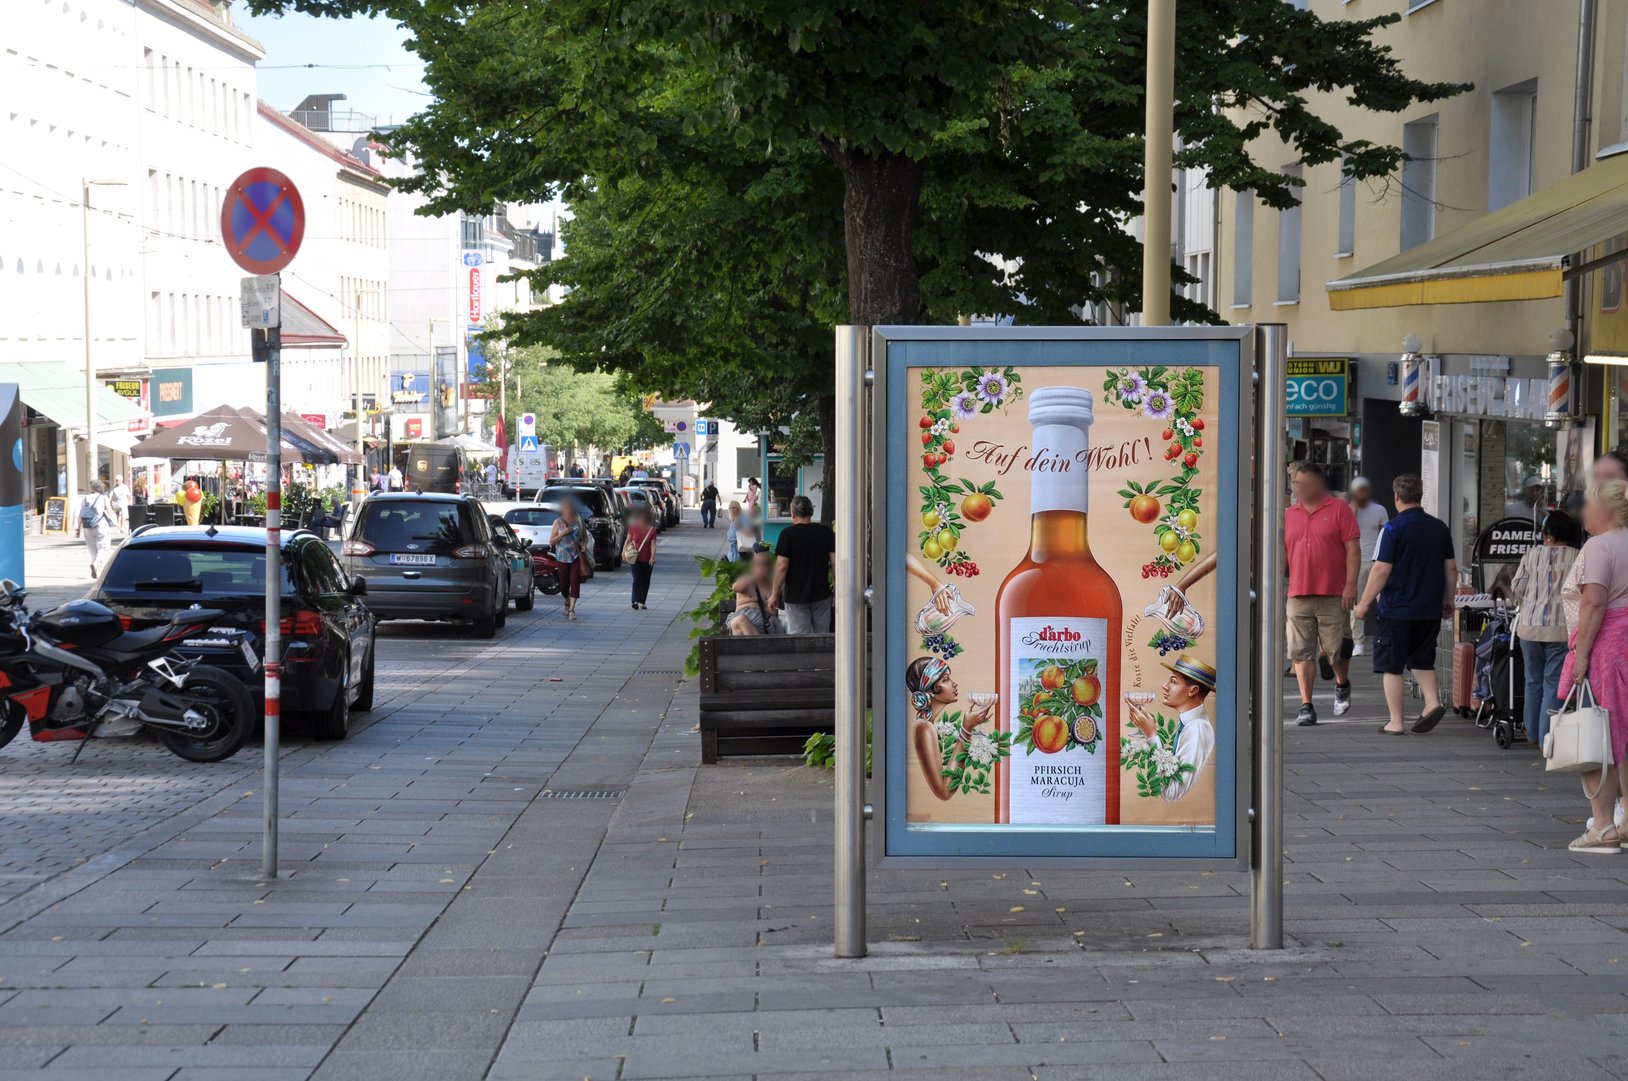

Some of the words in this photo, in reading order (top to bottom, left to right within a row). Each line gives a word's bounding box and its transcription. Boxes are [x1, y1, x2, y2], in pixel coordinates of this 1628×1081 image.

[470, 271, 480, 318] Hartlauer
[115, 381, 140, 390] FRISEUR
[176, 436, 232, 446] Kozel
[966, 440, 1027, 476] Auf
[1024, 448, 1071, 472] dein
[1491, 530, 1543, 541] DAMEN
[1125, 614, 1142, 647] Vielfalt!
[1021, 631, 1092, 653] Fruchtsirup
[1128, 648, 1138, 662] die
[1133, 664, 1142, 688] Koste
[1034, 765, 1082, 775] PFIRSICH
[1030, 775, 1085, 788] MARACUJA
[1041, 785, 1073, 801] Sirup
